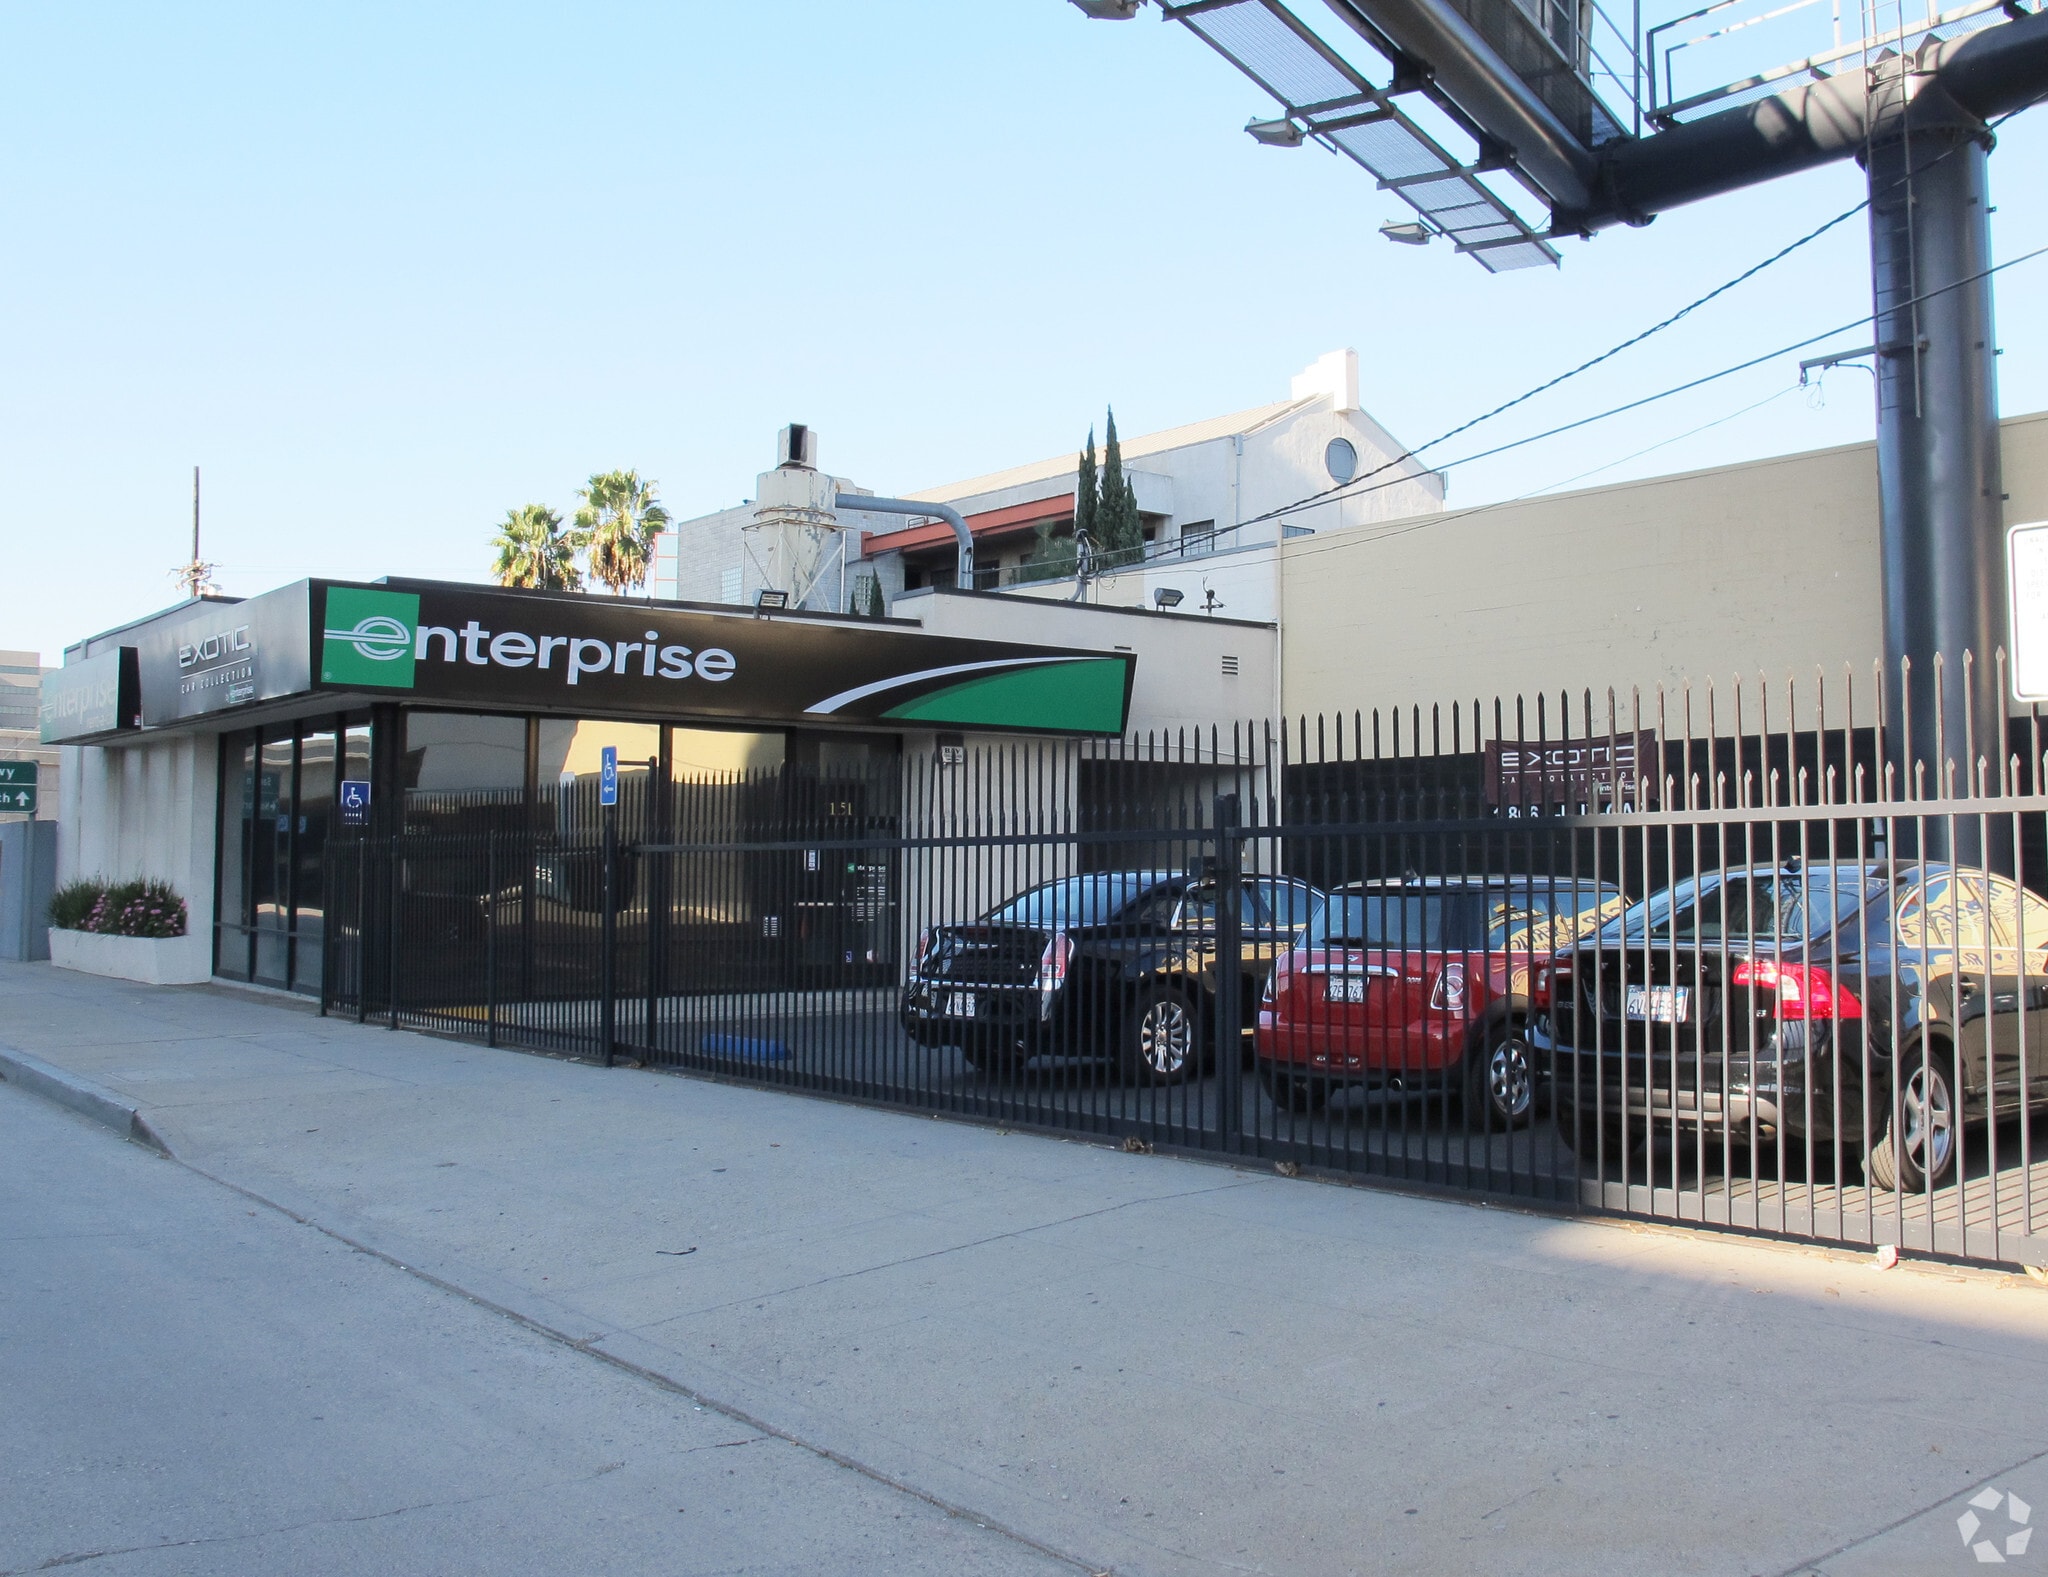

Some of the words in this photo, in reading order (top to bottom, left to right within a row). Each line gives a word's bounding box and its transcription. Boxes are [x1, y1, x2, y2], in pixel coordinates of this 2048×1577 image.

[178, 624, 251, 668] EXOTIC
[324, 616, 736, 685] enterprise
[200, 666, 253, 689] COLLECTION
